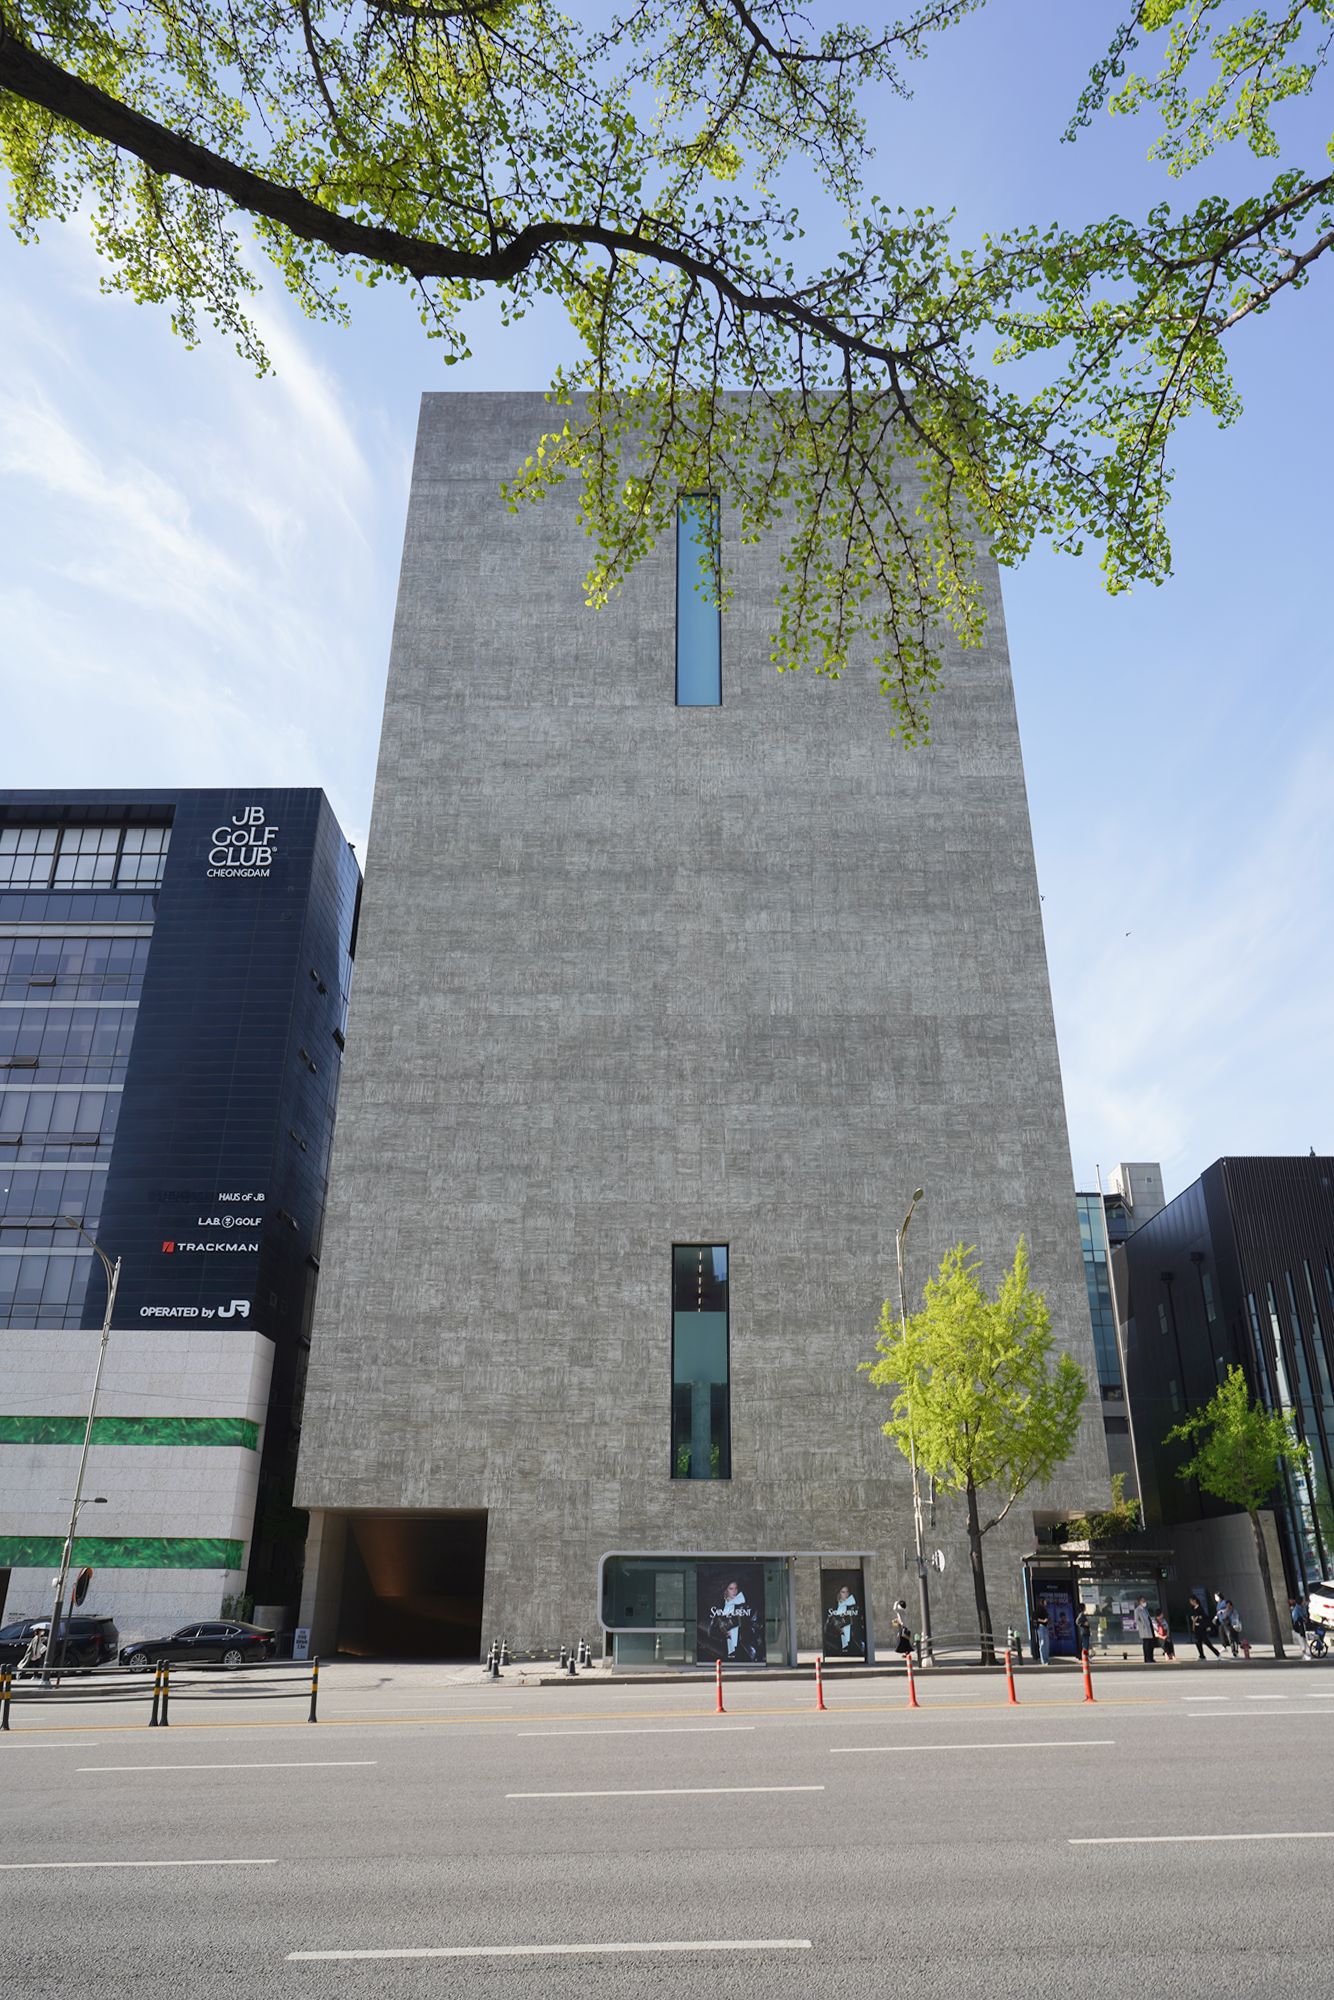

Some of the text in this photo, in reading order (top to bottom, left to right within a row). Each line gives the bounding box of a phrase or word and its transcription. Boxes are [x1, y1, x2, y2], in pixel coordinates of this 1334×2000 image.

[232, 806, 265, 826] JB
[206, 868, 270, 878] CHEONGDAM
[218, 1192, 241, 1202] HAUS
[253, 1192, 265, 1202] JB
[235, 1217, 263, 1226] GOLF
[177, 1242, 259, 1252] TRACKMAN
[139, 1306, 199, 1317] OPERATED
[201, 1307, 216, 1319] by
